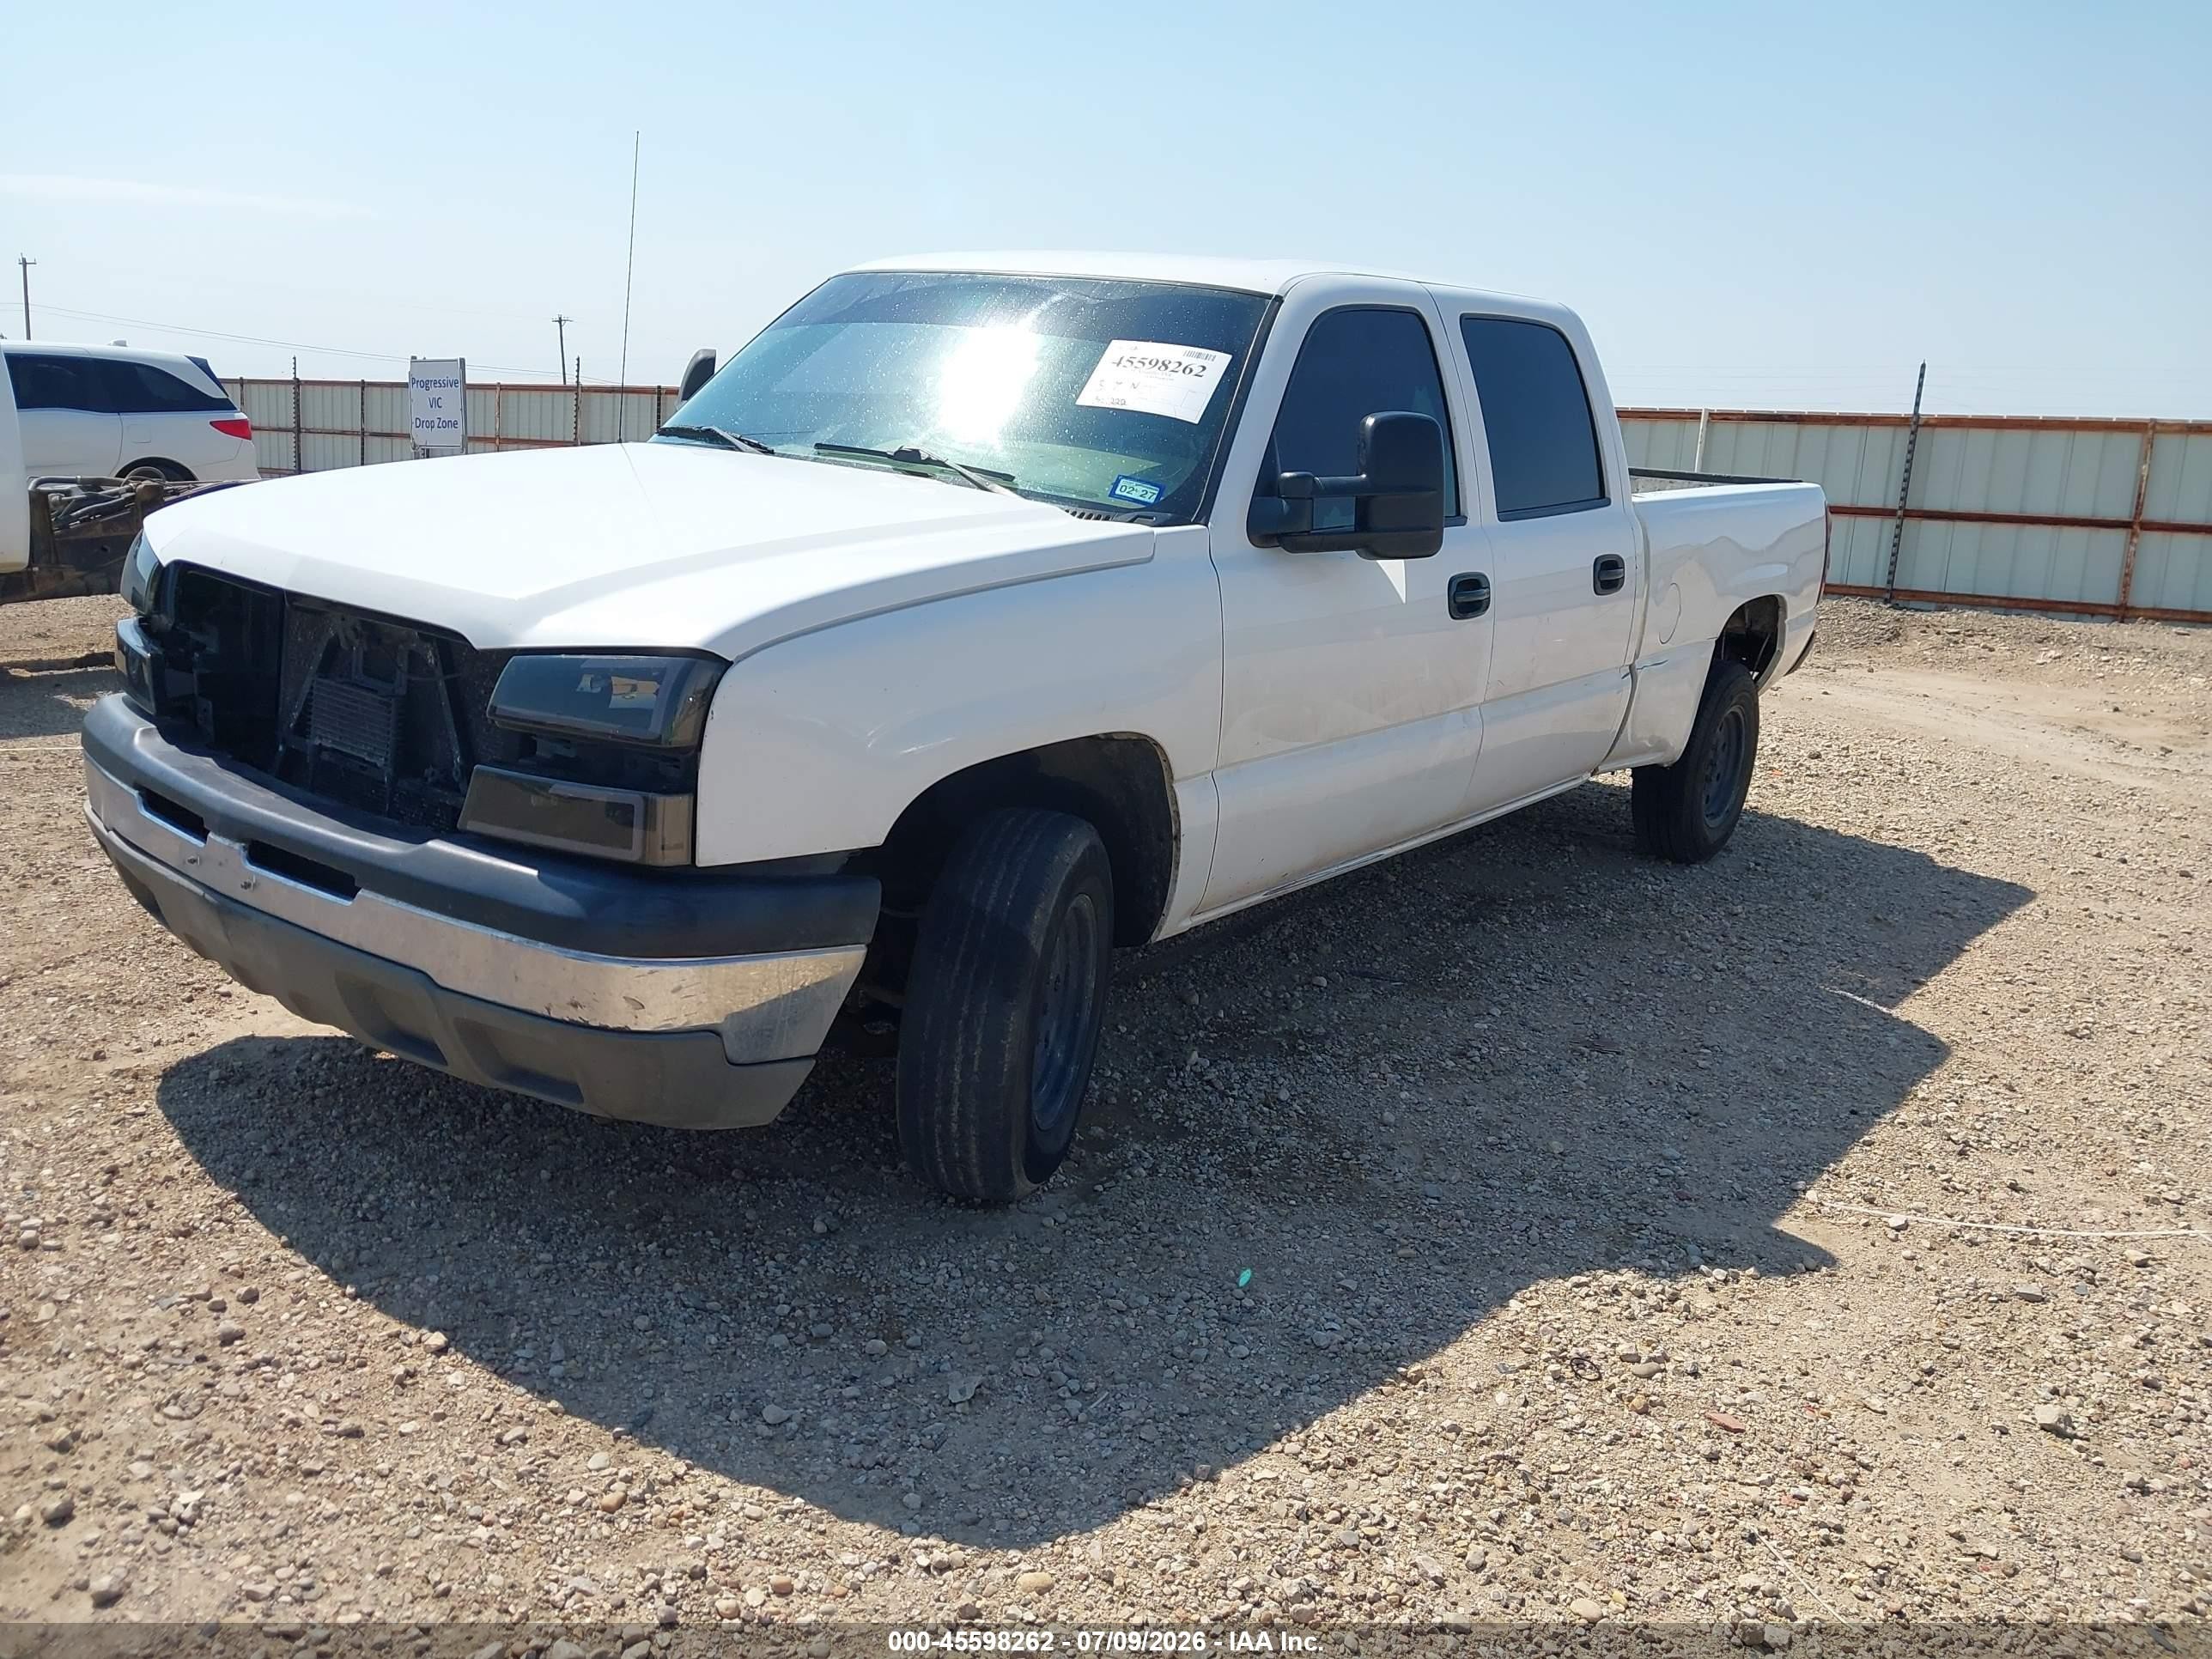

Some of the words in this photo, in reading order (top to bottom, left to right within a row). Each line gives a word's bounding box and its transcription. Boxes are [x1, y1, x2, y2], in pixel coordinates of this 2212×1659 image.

[1111, 356, 1207, 378] 45598262
[412, 377, 459, 391] Progressive
[428, 397, 442, 409] VIC
[415, 417, 434, 432] Drop
[436, 417, 459, 429] Zone
